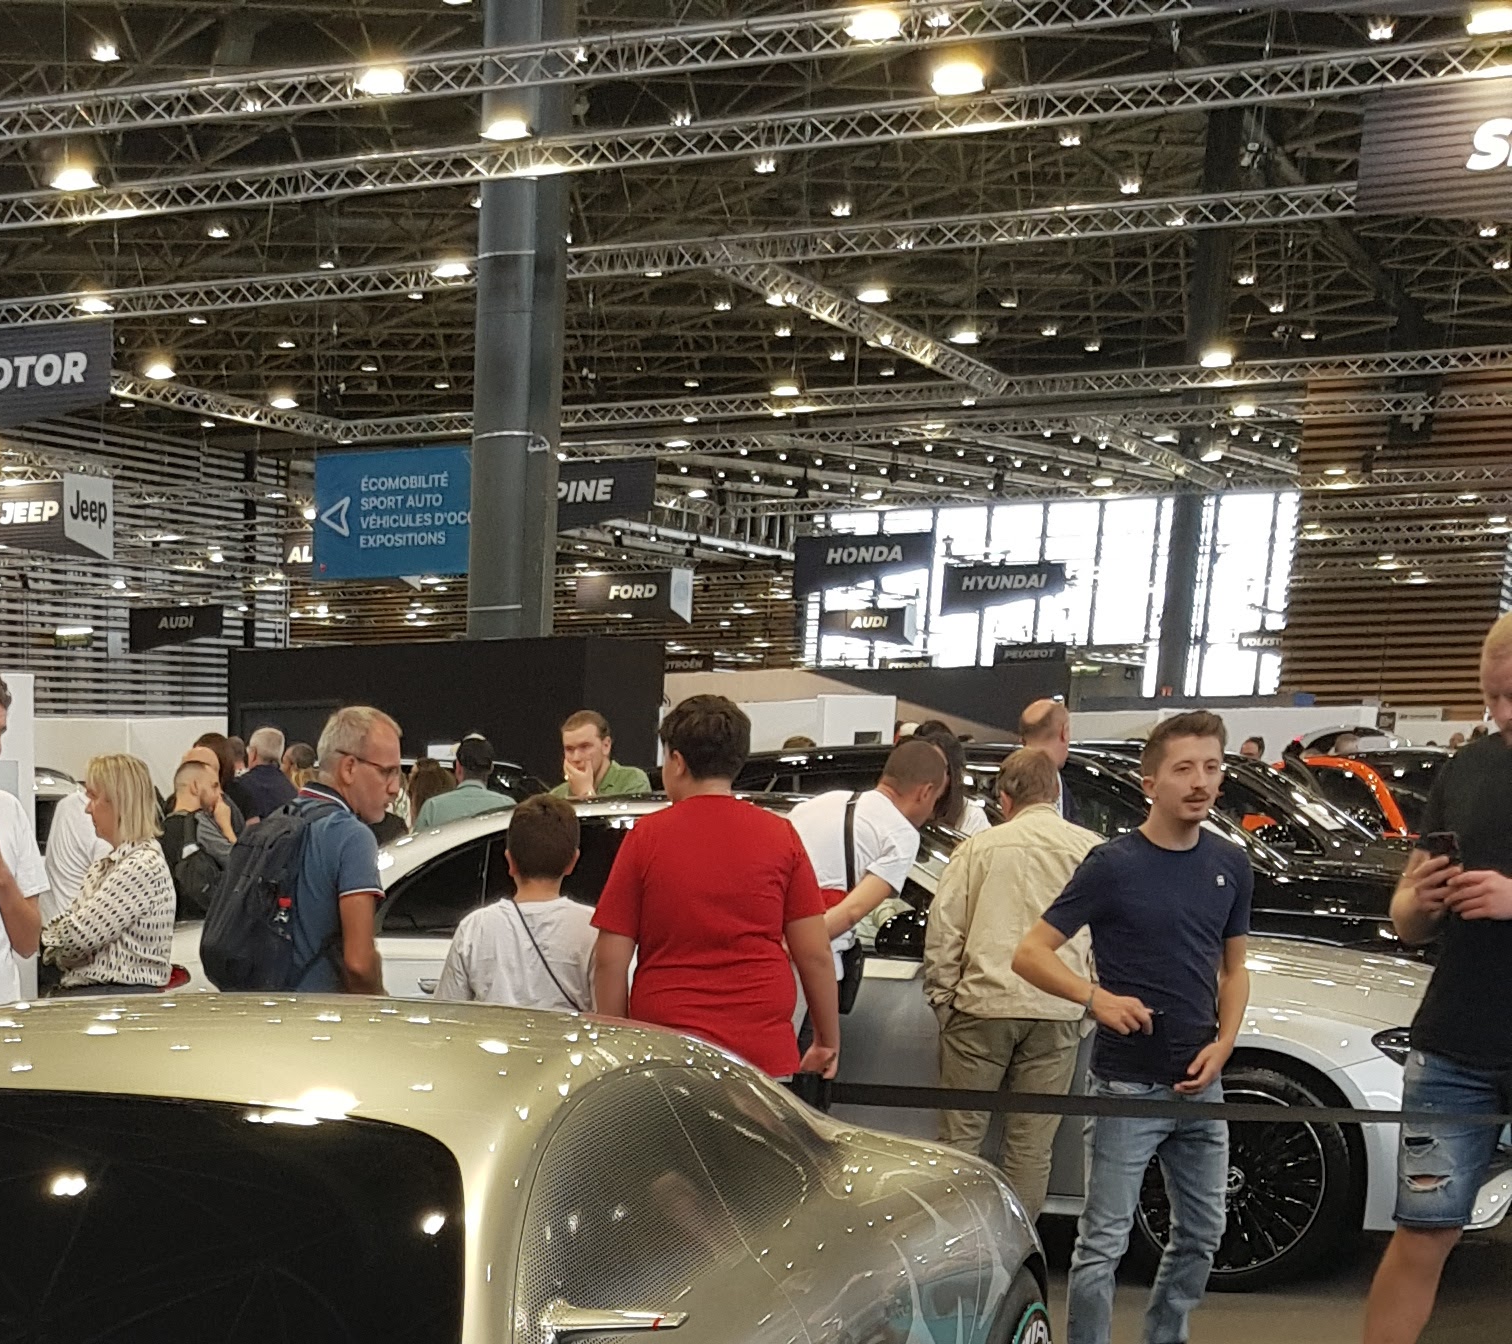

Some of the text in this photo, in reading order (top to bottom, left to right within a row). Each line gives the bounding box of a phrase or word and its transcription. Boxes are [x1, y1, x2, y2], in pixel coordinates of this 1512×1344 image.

[1466, 117, 1512, 172] S
[360, 471, 450, 491] ÉCOMOBILITÉ
[70, 490, 108, 529] Jeep
[360, 494, 443, 511] SPORT AUTO
[0, 500, 60, 525] JEEP
[360, 512, 432, 529] VÉHICULES
[359, 532, 446, 548] EXPOSITIONS
[287, 546, 313, 563] AL
[825, 545, 903, 565] HONDA
[961, 573, 1047, 591] HYUNDAI
[608, 584, 657, 600] FORD
[158, 616, 195, 630] AUDI
[850, 615, 889, 629] AUDI
[1004, 649, 1055, 660] PEUGEOT
[665, 658, 704, 670] ITROËN
